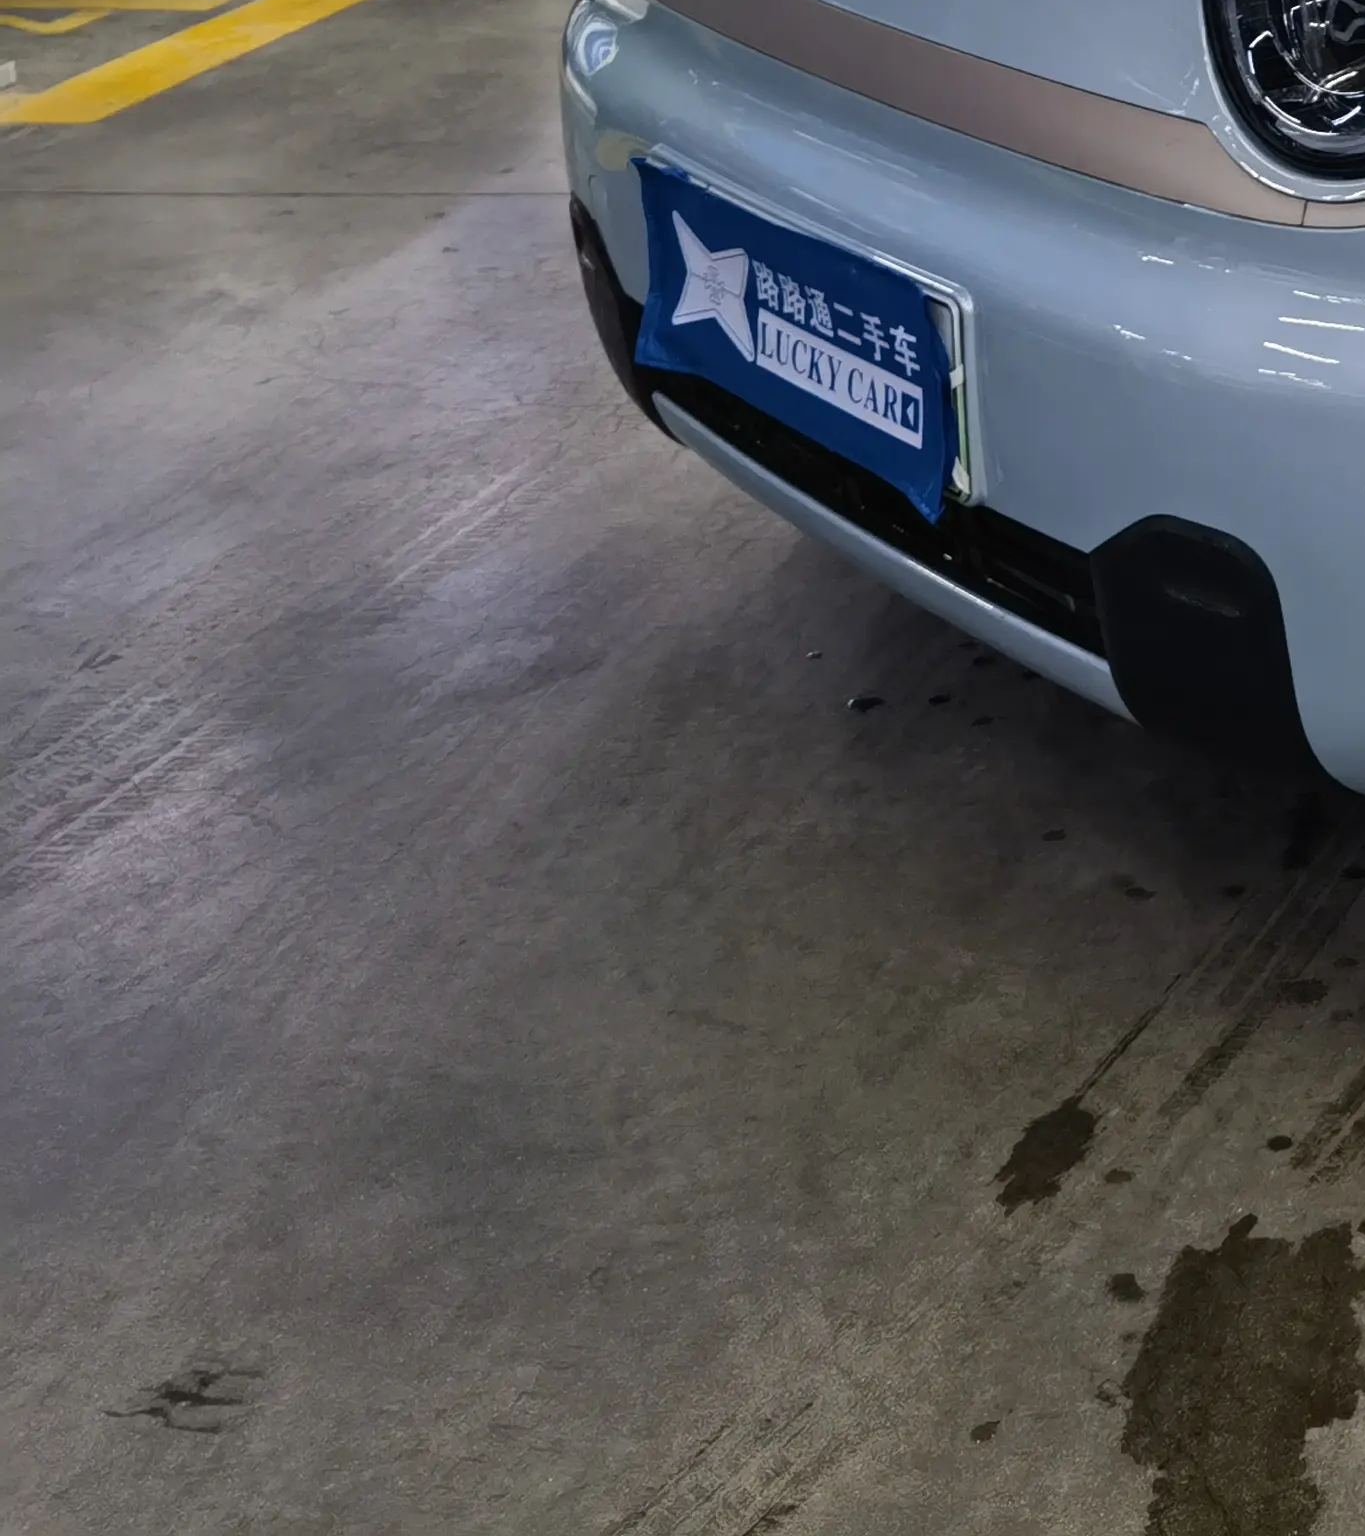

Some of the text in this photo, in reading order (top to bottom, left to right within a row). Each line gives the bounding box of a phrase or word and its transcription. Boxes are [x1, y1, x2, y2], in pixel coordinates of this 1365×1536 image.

[751, 259, 921, 377] 路路通二手车
[759, 321, 900, 426] LUCKY CAR
